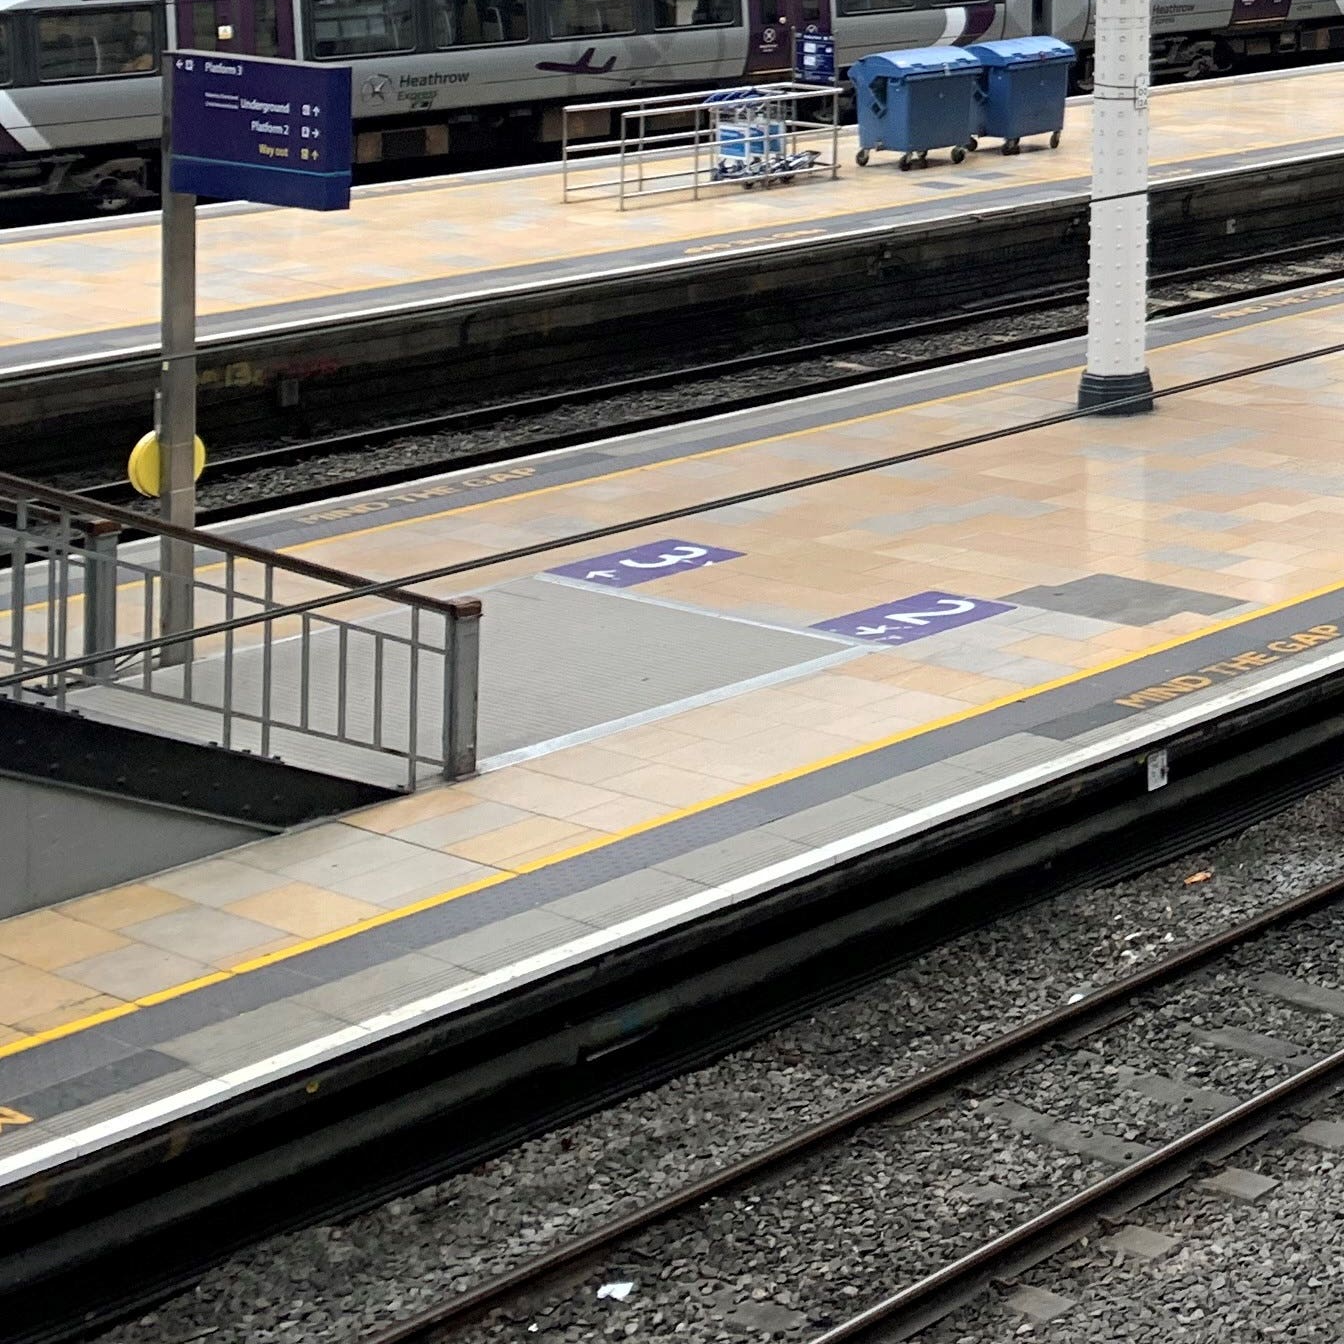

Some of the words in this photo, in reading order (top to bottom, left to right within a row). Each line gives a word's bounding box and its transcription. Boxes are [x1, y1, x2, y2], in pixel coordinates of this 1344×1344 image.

[205, 62, 236, 75] Platform
[237, 65, 243, 76] 3
[399, 72, 470, 88] Heathrow
[240, 99, 290, 114] Underground
[251, 120, 283, 134] Platform
[283, 124, 290, 136] 2
[259, 143, 274, 157] Way
[388, 484, 459, 503] THE
[462, 467, 536, 488] GAP
[618, 546, 709, 568] 3
[884, 598, 976, 626] 2
[1113, 674, 1213, 709] MIND
[1200, 650, 1281, 676] THE
[1267, 623, 1343, 654] GAP
